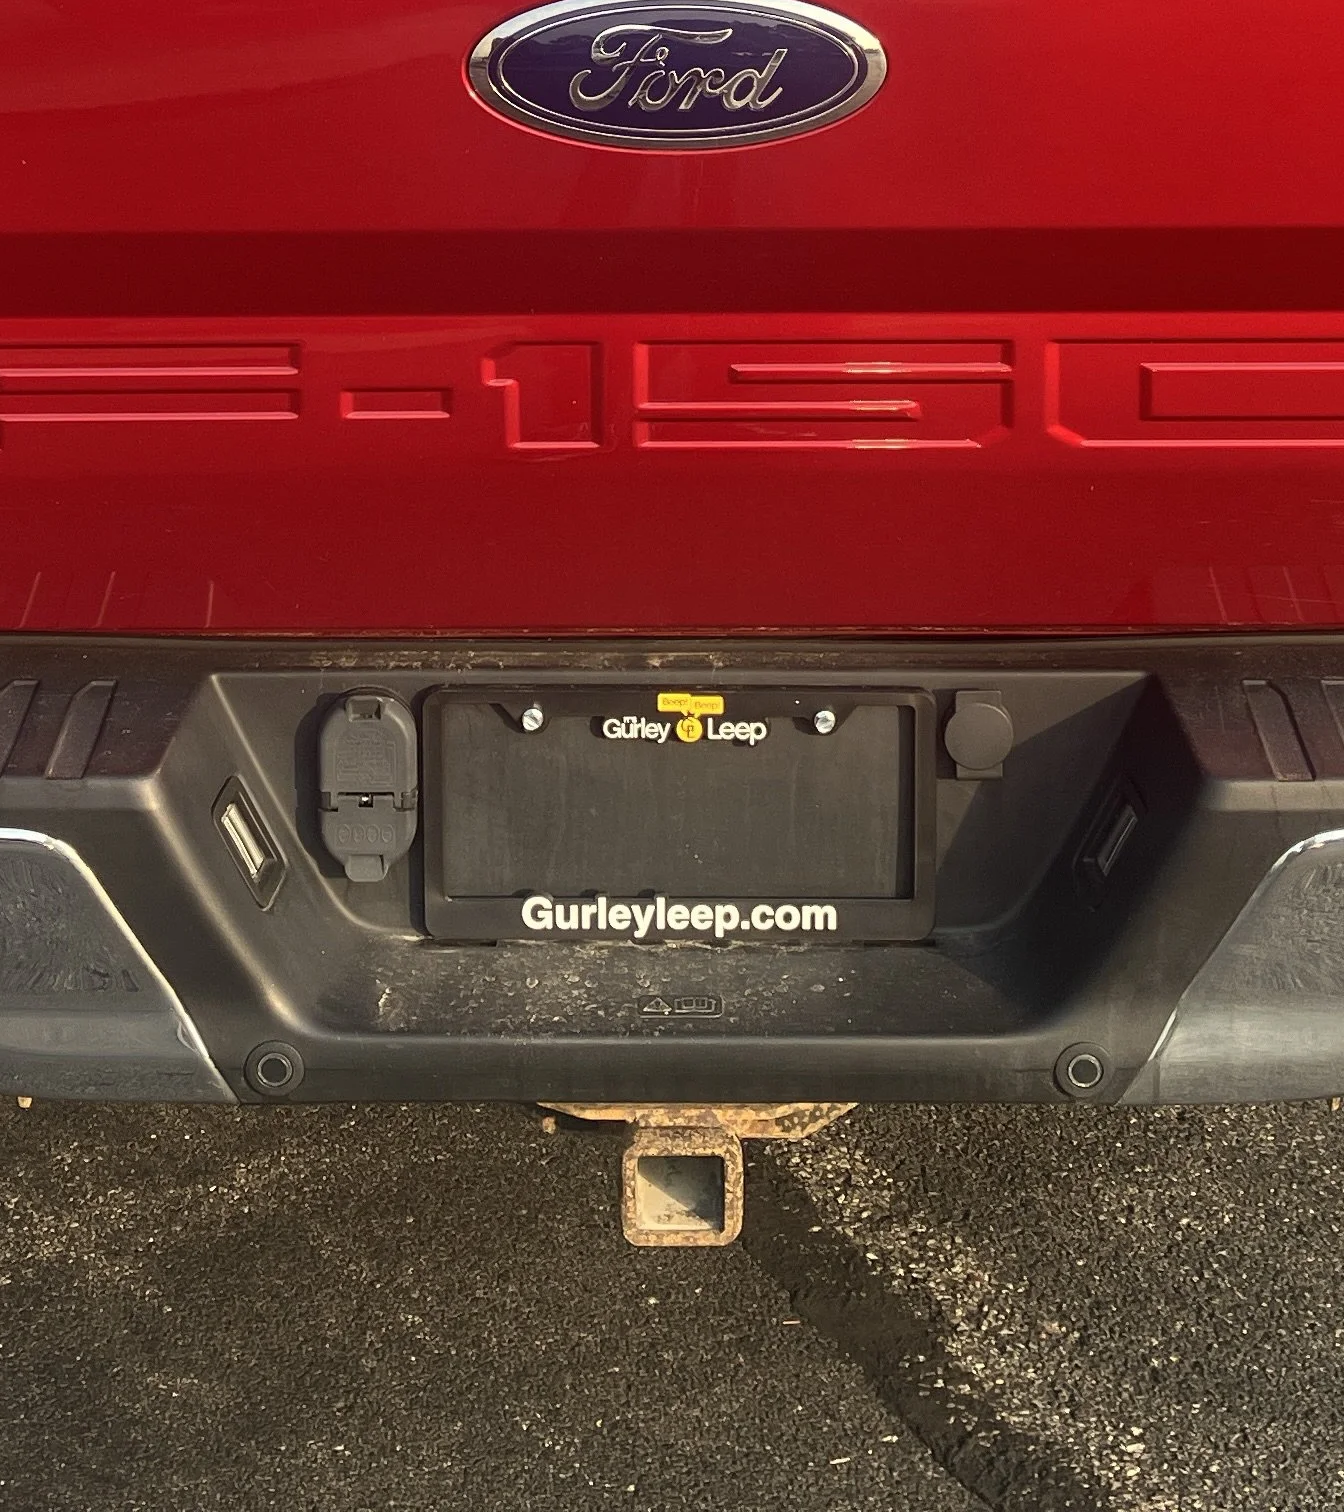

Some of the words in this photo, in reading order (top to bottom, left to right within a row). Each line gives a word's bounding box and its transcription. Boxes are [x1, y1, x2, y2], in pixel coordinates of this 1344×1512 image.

[568, 23, 789, 112] Ford
[707, 718, 767, 746] Leep
[521, 895, 838, 938] Gurleyleep.com
